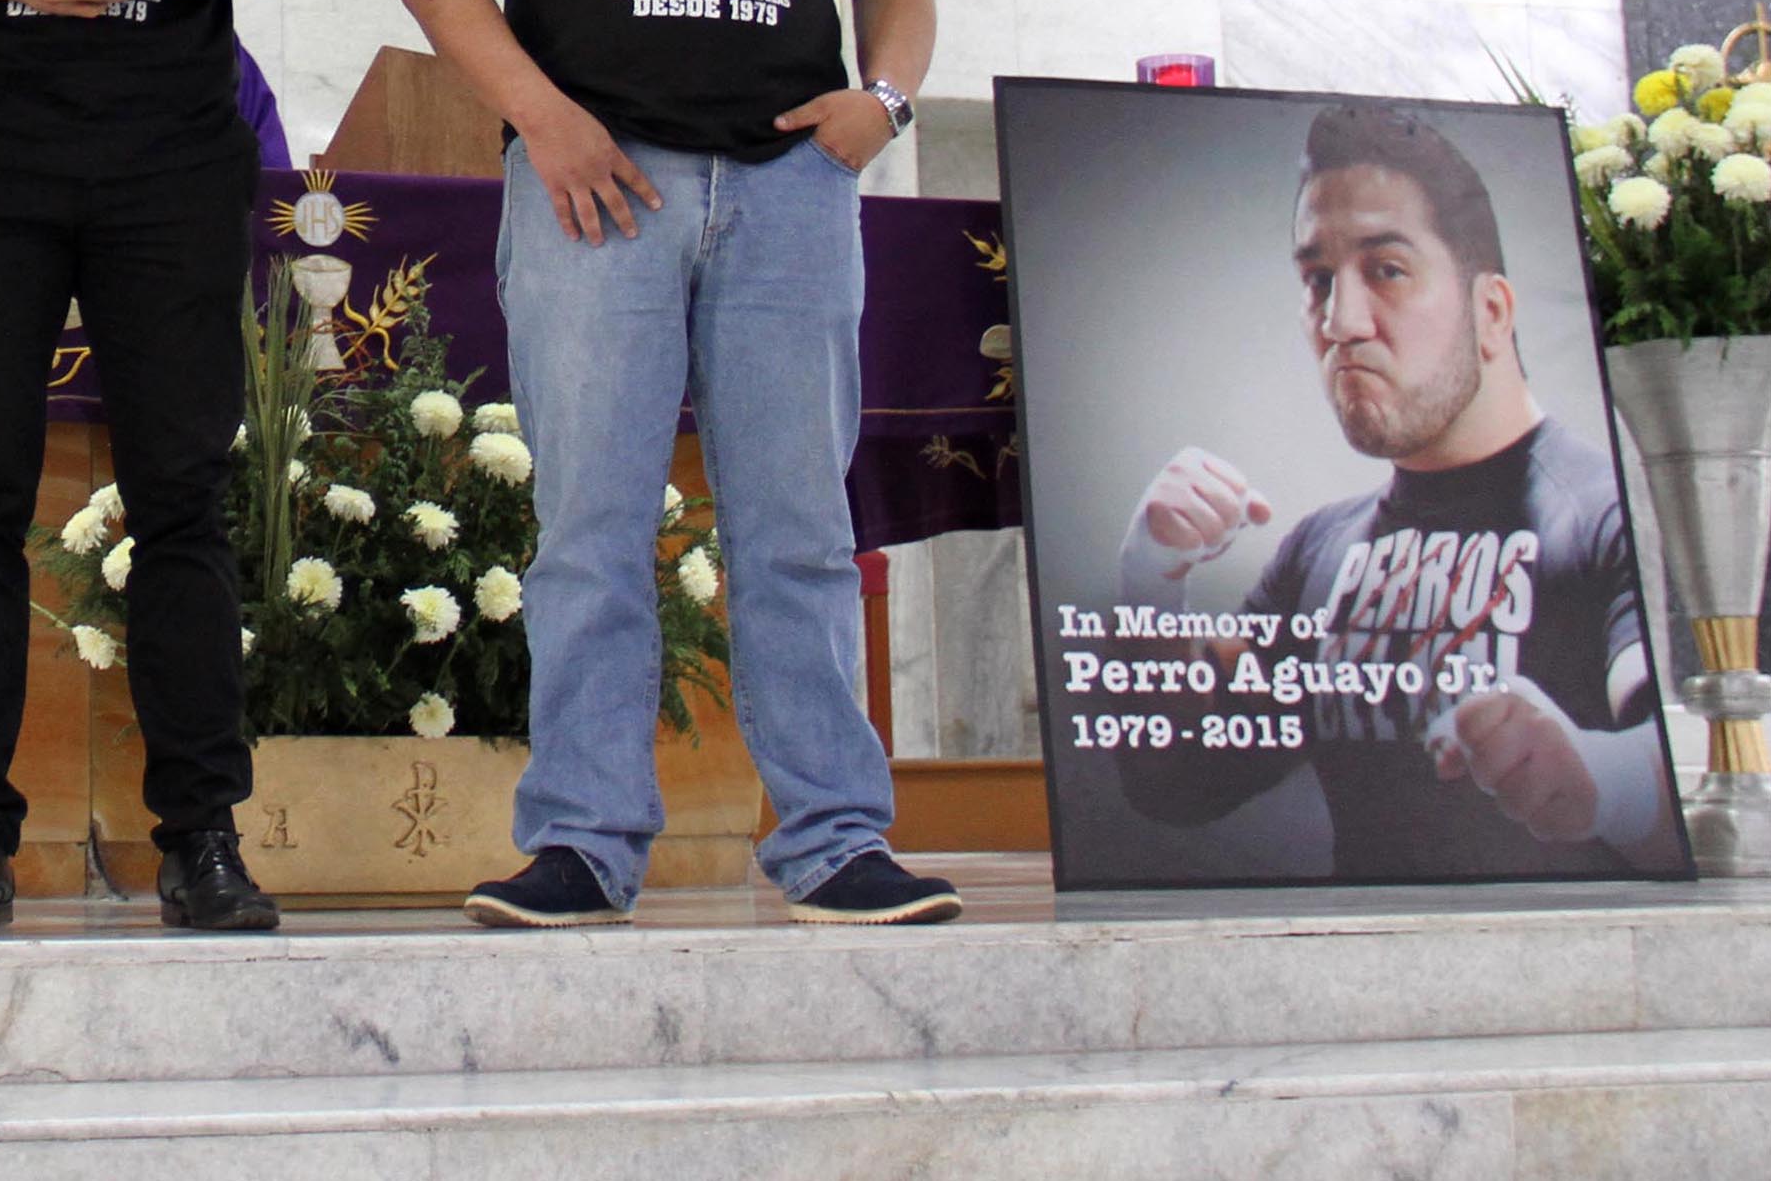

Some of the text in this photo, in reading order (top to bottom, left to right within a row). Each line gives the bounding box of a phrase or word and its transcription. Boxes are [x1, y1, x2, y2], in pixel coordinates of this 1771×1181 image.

[1325, 528, 1539, 633] PERROS
[1058, 605, 1105, 637] In
[1114, 605, 1282, 647] Memory
[1290, 608, 1328, 639] of
[1063, 652, 1509, 704] Perro Aguayo Jr.
[1072, 715, 1173, 748] 1979
[1201, 715, 1304, 748] 2015
